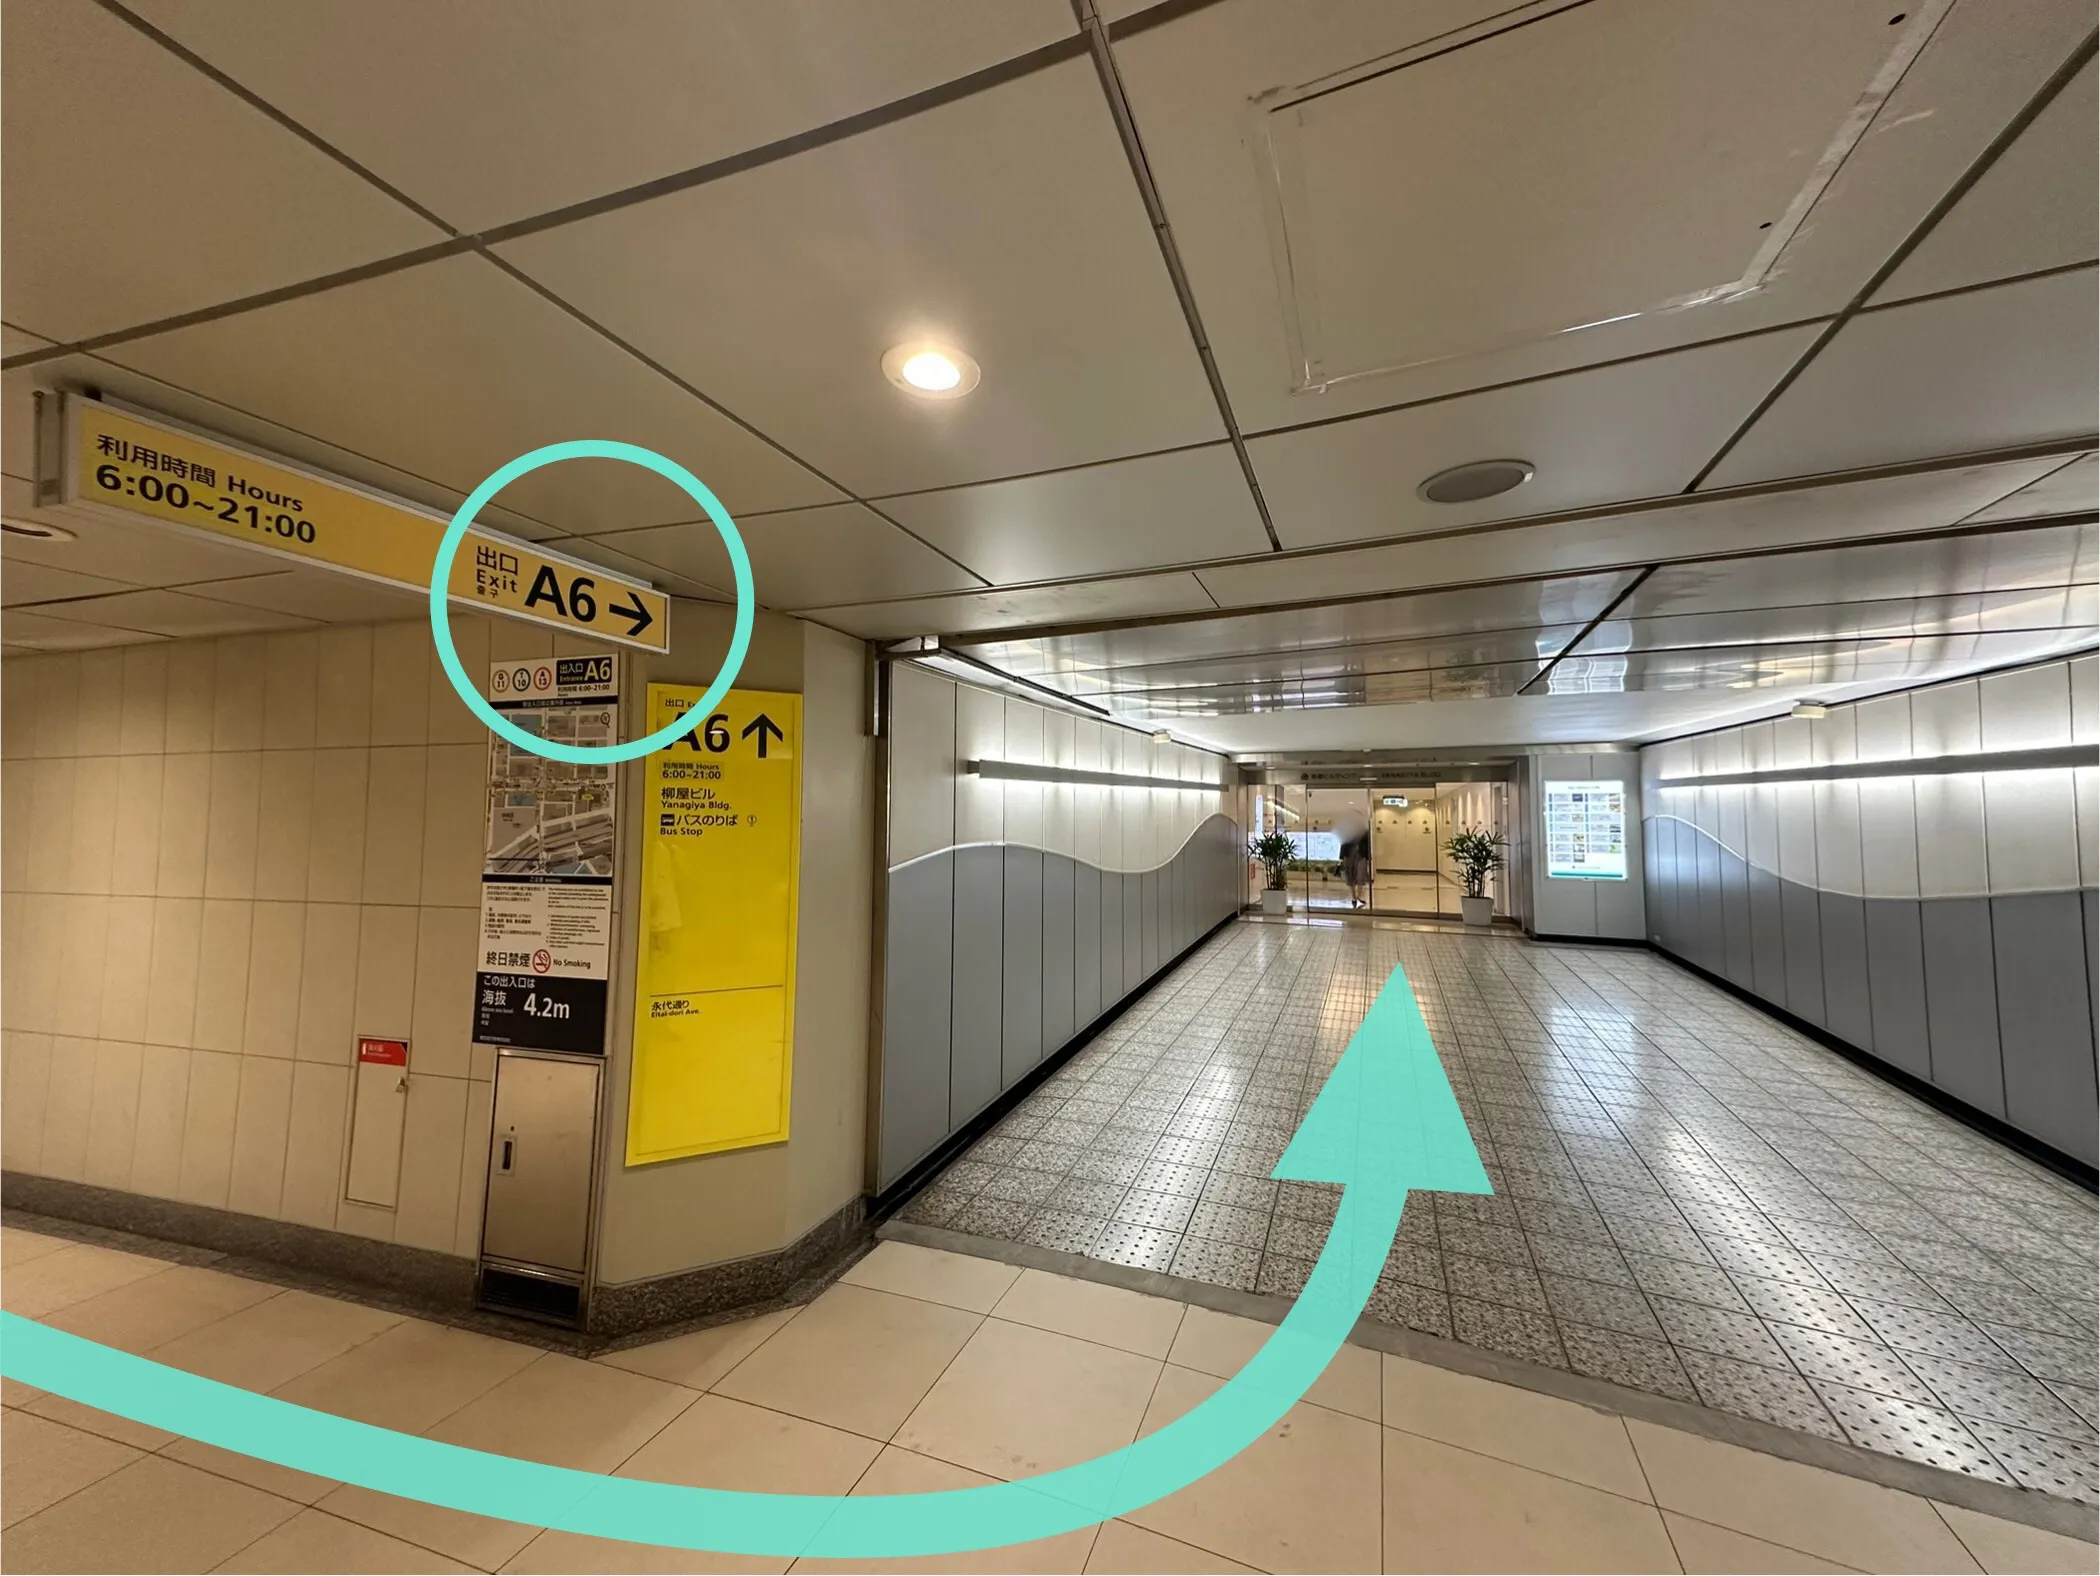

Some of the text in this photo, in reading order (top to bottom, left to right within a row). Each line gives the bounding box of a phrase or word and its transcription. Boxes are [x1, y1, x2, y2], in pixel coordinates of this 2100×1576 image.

[97, 433, 303, 512] 利用時間 Hours
[96, 464, 316, 544] 6:00~21:00
[476, 545, 518, 576] 出口
[476, 568, 517, 593] Exit
[524, 564, 597, 623] A6
[559, 662, 584, 674] 出入口
[584, 659, 611, 681] A6
[497, 680, 505, 688] 11
[518, 679, 526, 687] 10
[538, 678, 547, 686] 13
[665, 698, 684, 708] 出口
[696, 762, 720, 770] Hours
[661, 786, 716, 800] 柳屋ビル
[661, 801, 732, 811] Yanagiya Bldg.
[676, 813, 739, 826] バスのりば
[660, 827, 703, 837] Bus Stop
[486, 950, 531, 968] 終日禁煙
[553, 958, 591, 970] No Smoking
[483, 975, 536, 989] この出入口は
[481, 989, 507, 1006] 海抜
[523, 992, 570, 1019] 4.2m
[651, 1000, 690, 1011] 永代通り
